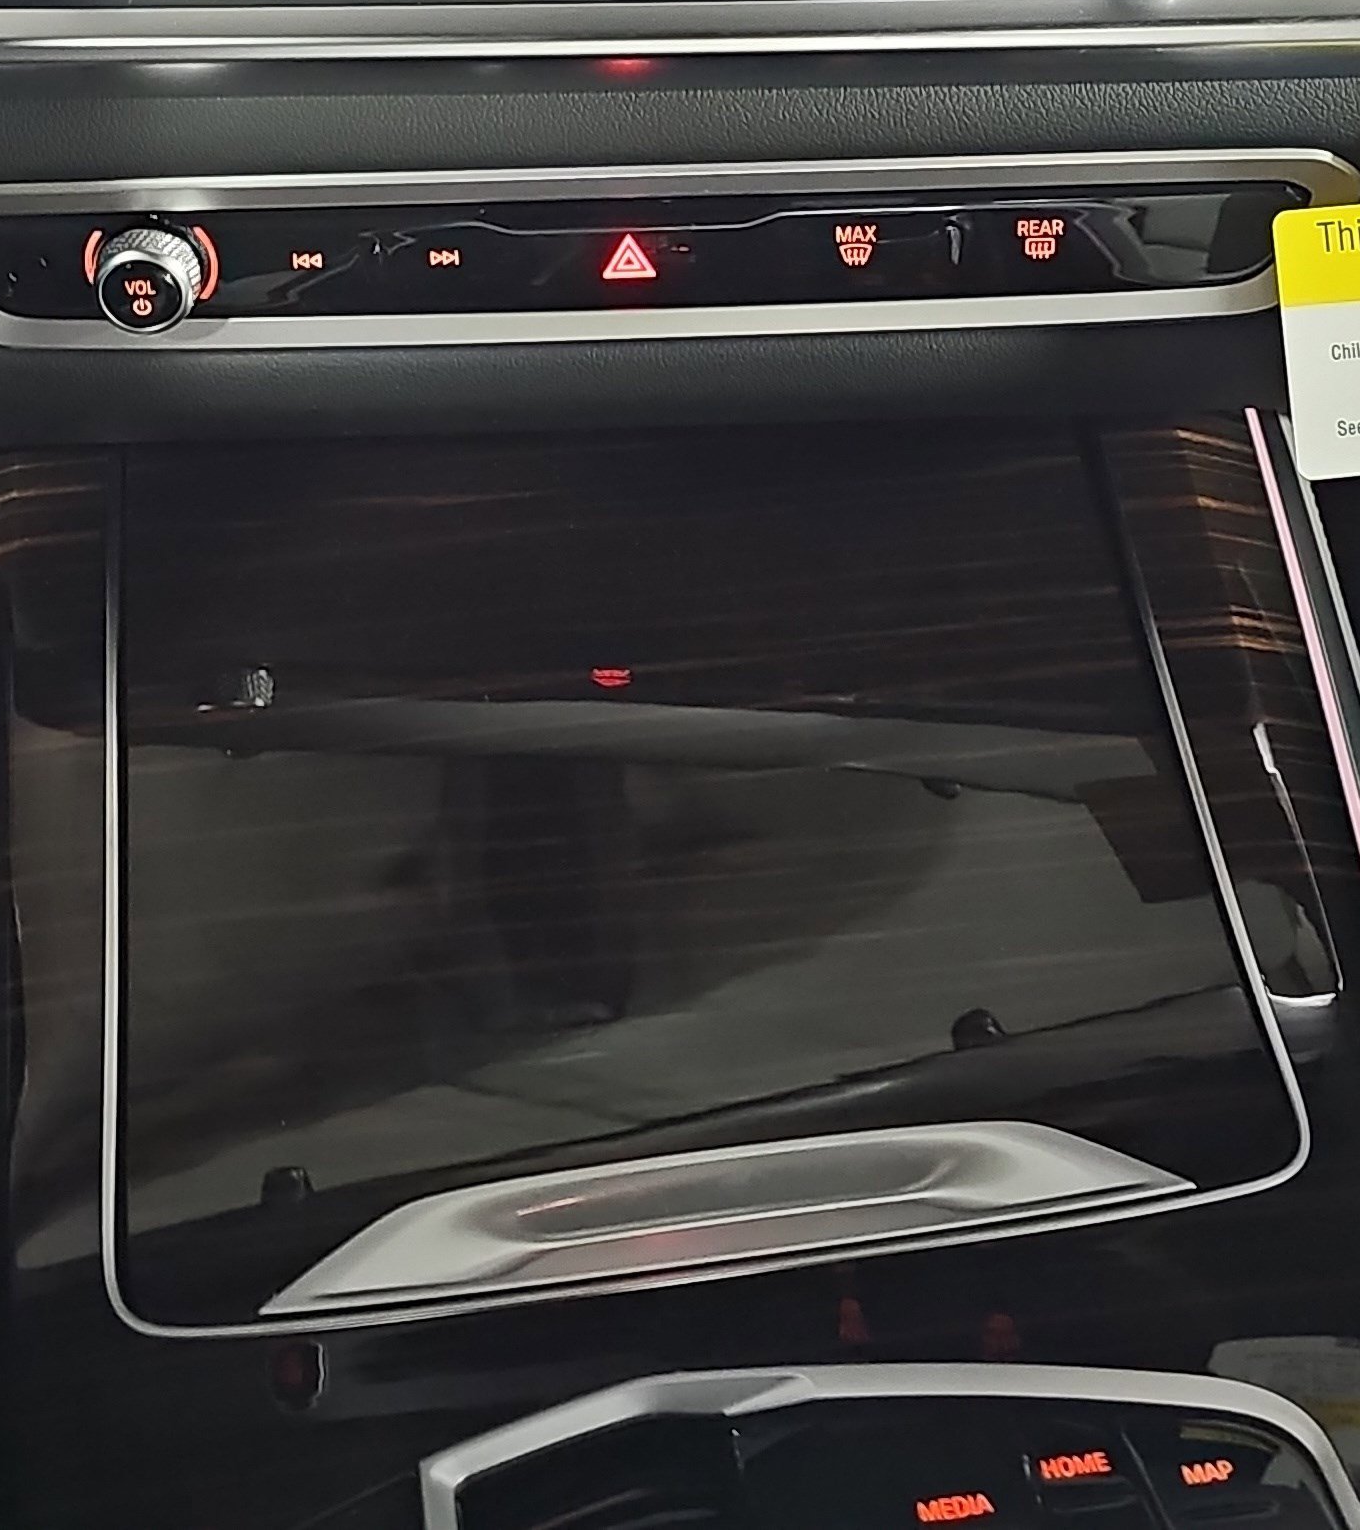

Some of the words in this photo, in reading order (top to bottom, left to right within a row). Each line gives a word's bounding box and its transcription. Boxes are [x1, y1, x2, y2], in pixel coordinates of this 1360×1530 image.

[835, 224, 877, 244] MAX
[1016, 219, 1064, 238] REAR
[124, 278, 156, 297] VOL
[1040, 1451, 1112, 1480] HOME
[1181, 1460, 1234, 1486] MAP
[916, 1493, 995, 1522] MEDIA
